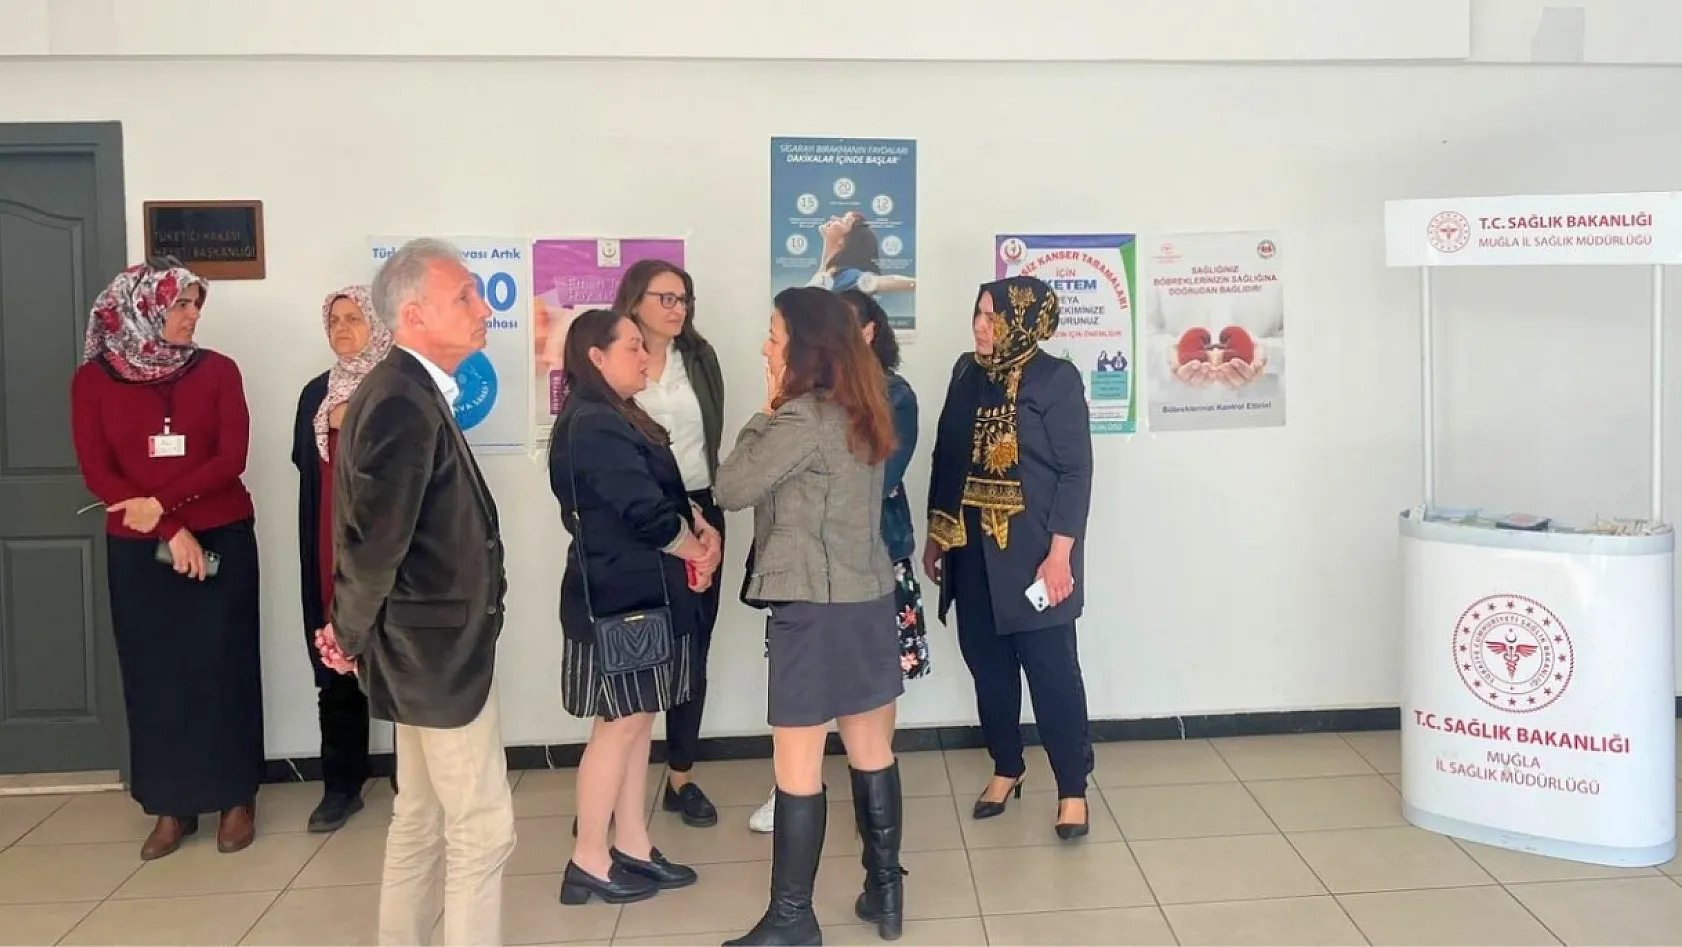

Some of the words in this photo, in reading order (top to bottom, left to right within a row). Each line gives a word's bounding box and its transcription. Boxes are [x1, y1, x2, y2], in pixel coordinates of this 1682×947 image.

[1479, 217, 1505, 230] T.C.
[1507, 213, 1563, 229] SAĞLIK
[1567, 211, 1653, 228] BAKANLIĞI
[1478, 236, 1520, 248] MUĞLA
[1533, 235, 1574, 247] SAĞLIK
[491, 247, 522, 259] Artık
[1036, 250, 1081, 265] KANSER
[1081, 252, 1129, 310] TARAMALARI
[1056, 266, 1077, 278] İÇİN
[1059, 296, 1080, 305] EYA
[485, 318, 518, 328] ahası
[1413, 709, 1441, 730] T.C.
[1443, 717, 1512, 741] SAĞLIK
[1516, 728, 1630, 754] BAKANLIĞI
[1486, 750, 1541, 770] MUĞLA
[1435, 756, 1449, 773] İL
[1449, 760, 1498, 781] SAĞLIK
[1500, 768, 1600, 796] MÜDÜRLÜĞÜ
